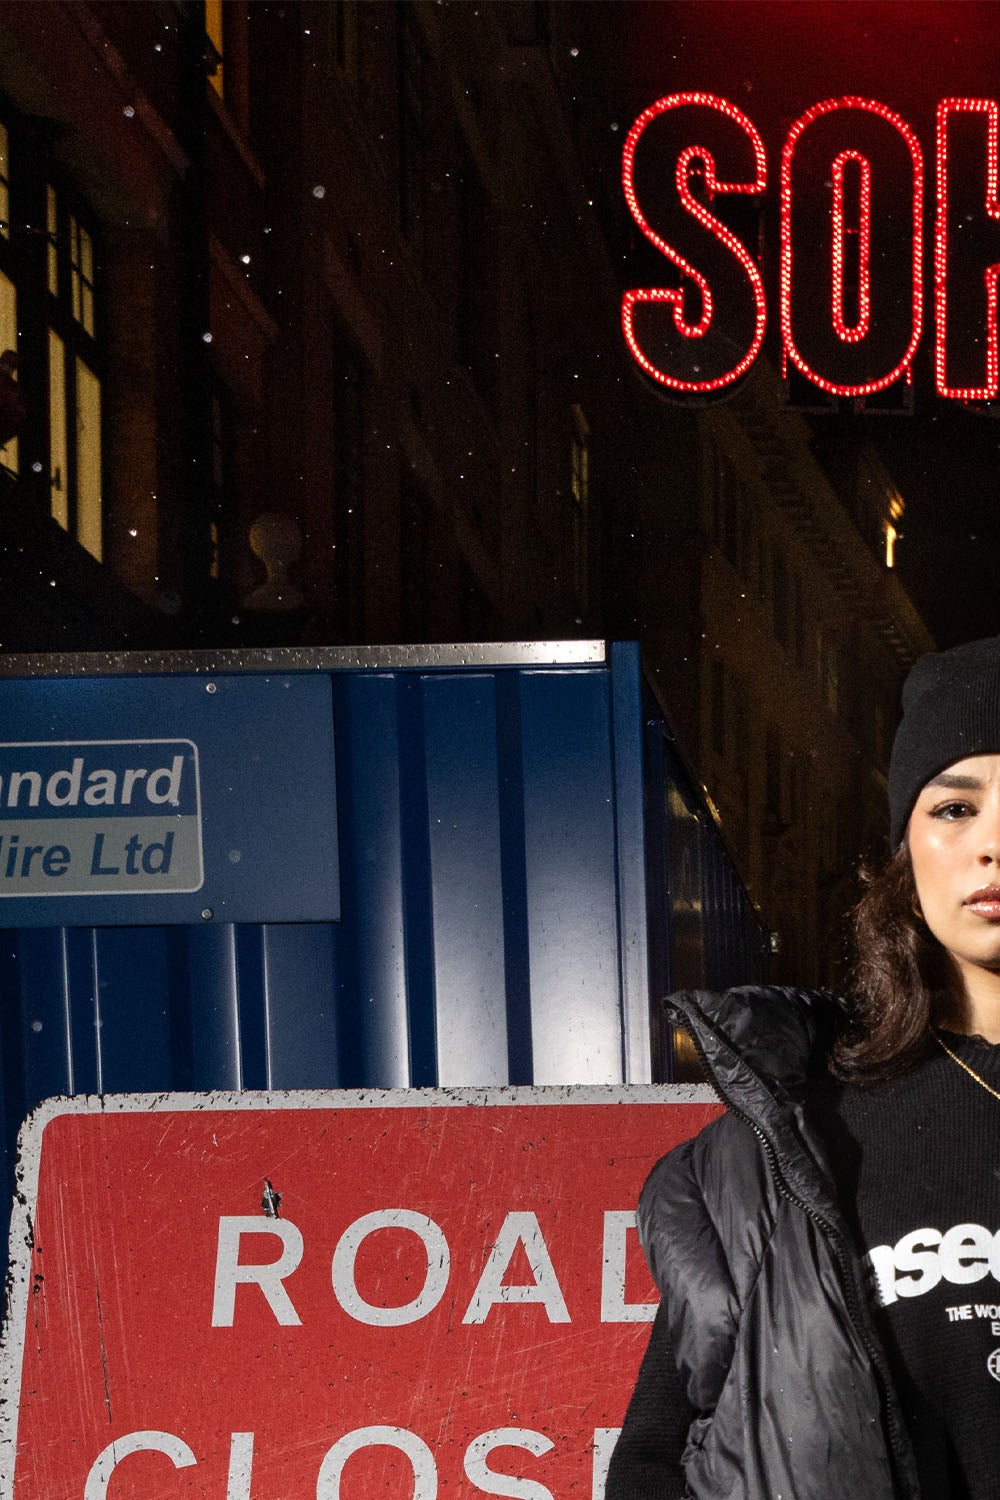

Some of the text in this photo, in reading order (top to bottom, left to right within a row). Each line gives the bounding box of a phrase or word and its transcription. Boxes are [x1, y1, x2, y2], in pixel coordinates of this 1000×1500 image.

[0, 755, 184, 807] ndard
[0, 831, 175, 877] ire Ltd
[945, 1304, 973, 1322] THE
